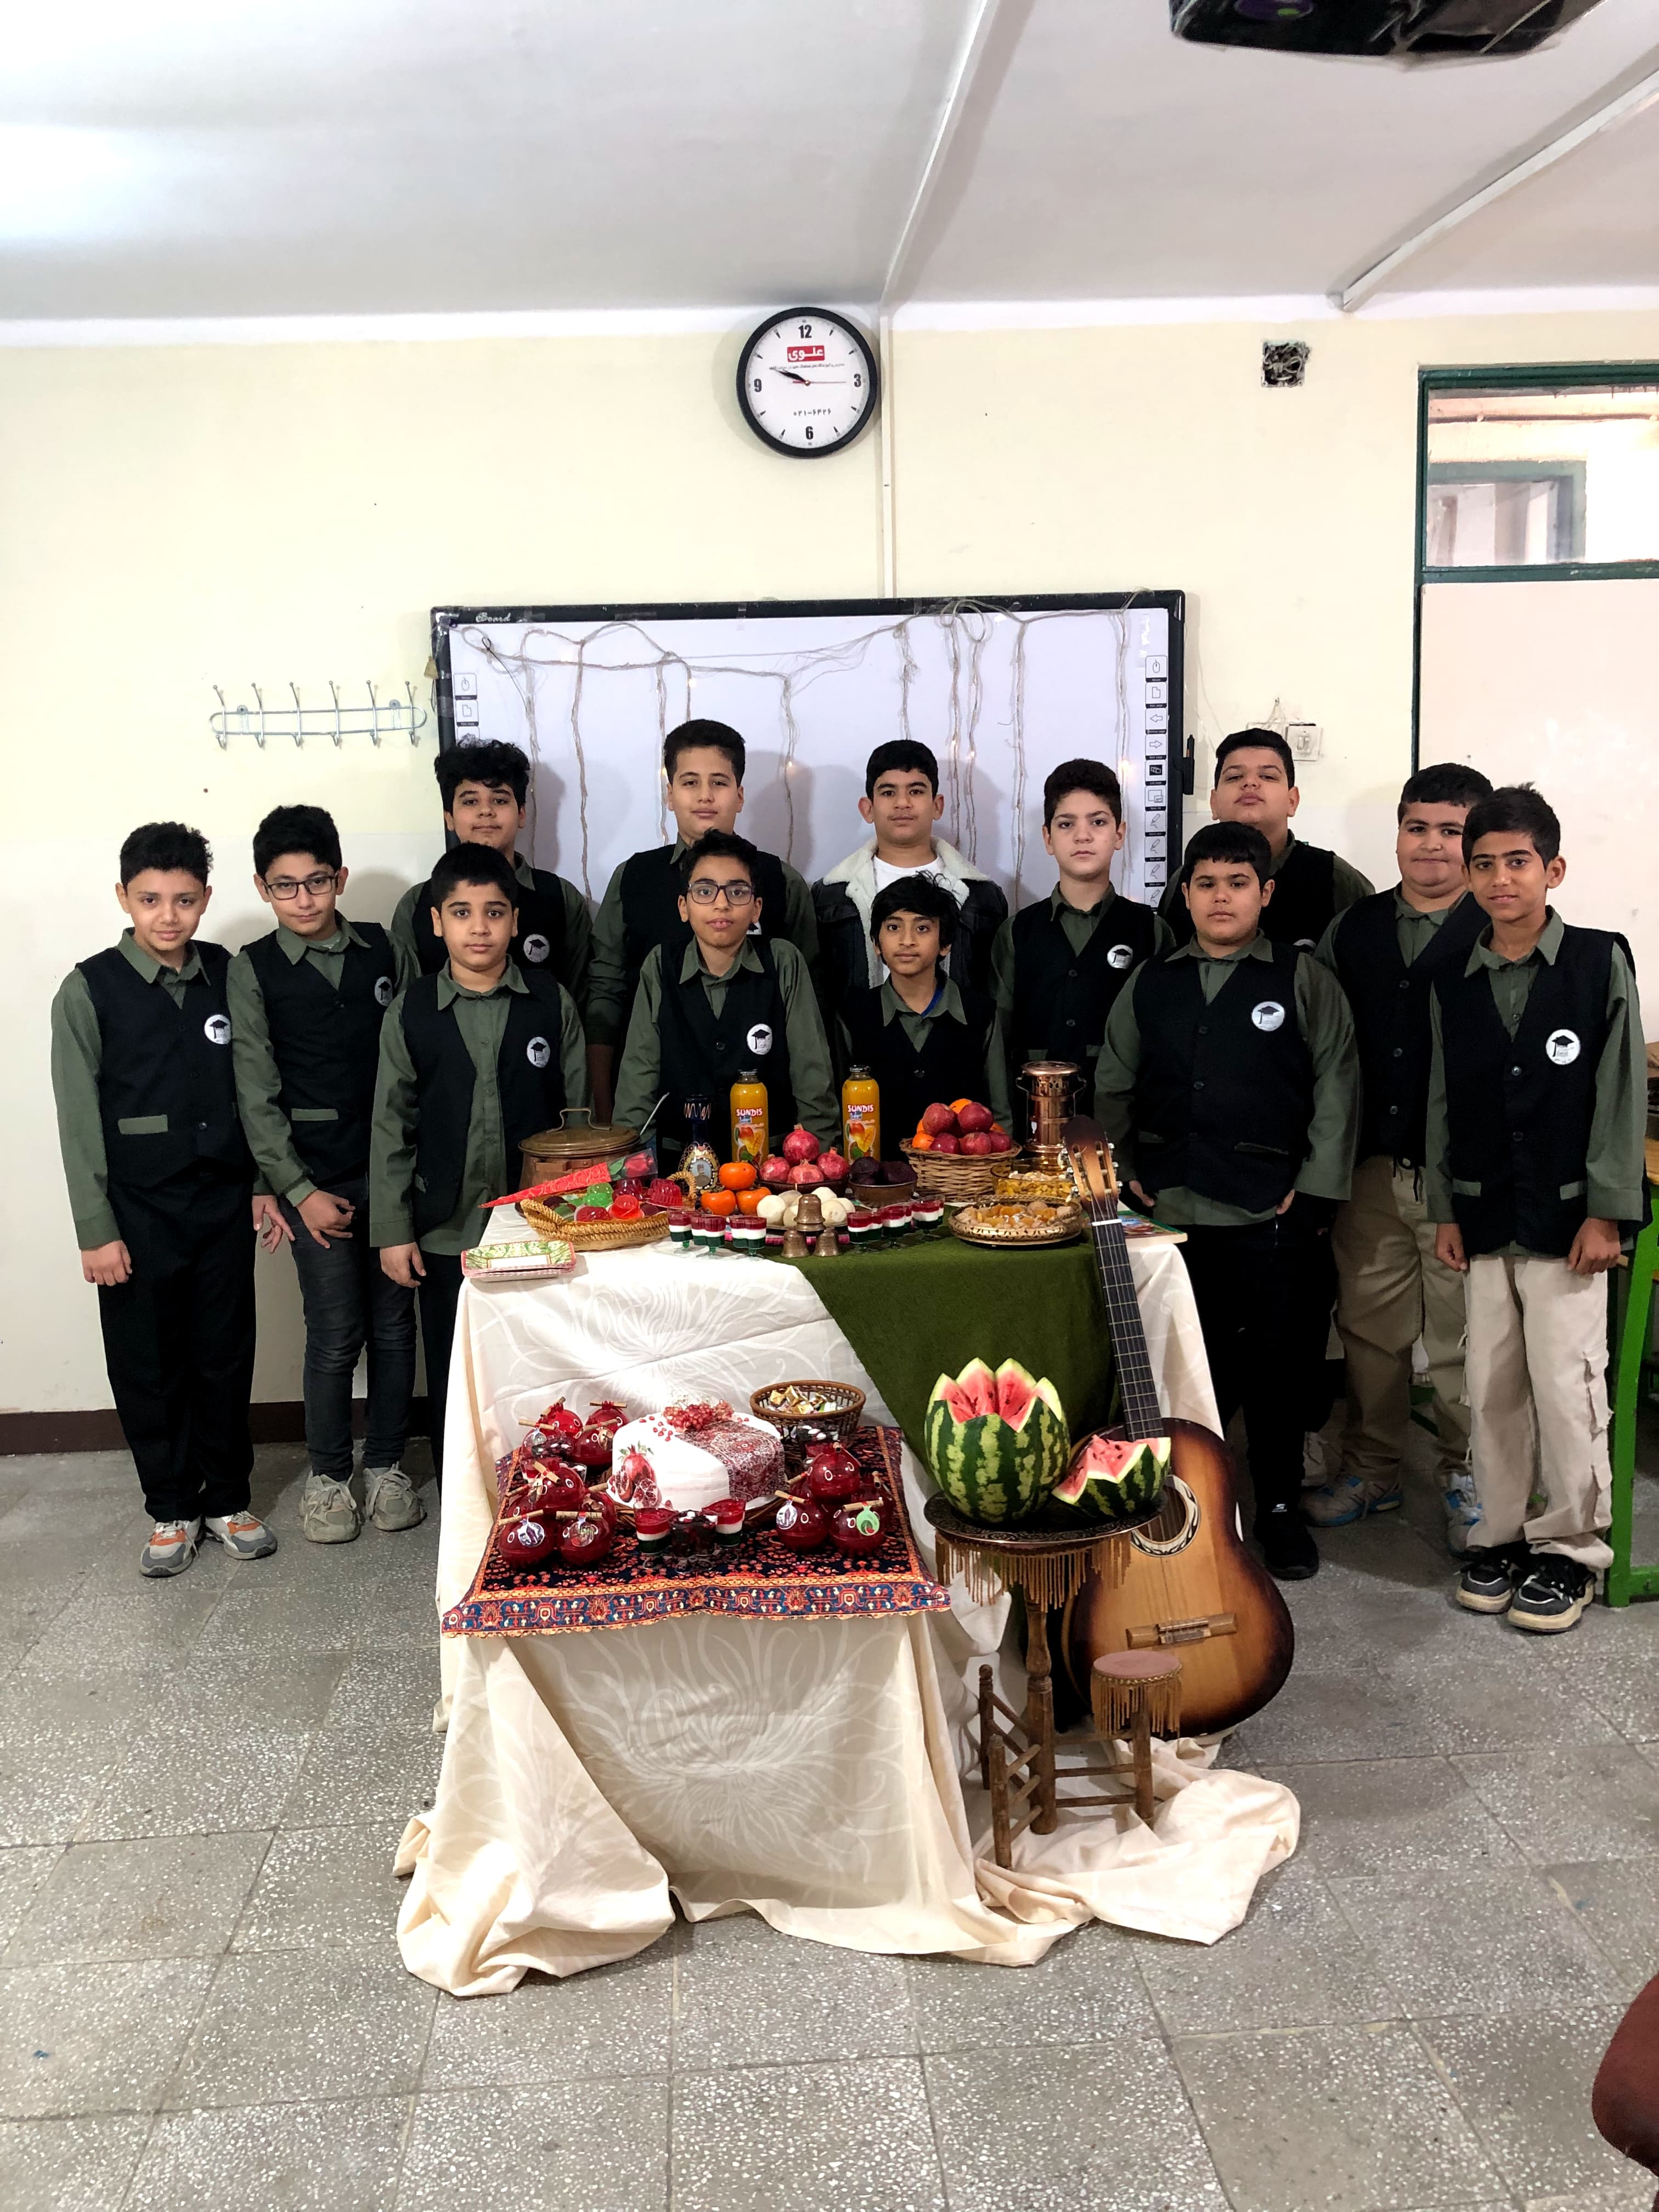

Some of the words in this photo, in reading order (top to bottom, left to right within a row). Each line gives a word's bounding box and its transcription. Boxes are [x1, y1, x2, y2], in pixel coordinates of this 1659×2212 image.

[798, 324, 812, 338] 12
[788, 347, 823, 360] علوی
[754, 379, 762, 392] 9
[854, 374, 861, 387] 3
[805, 426, 814, 439] 6
[736, 1108, 763, 1116] SUNDIS
[847, 1104, 874, 1113] SUNDIS
